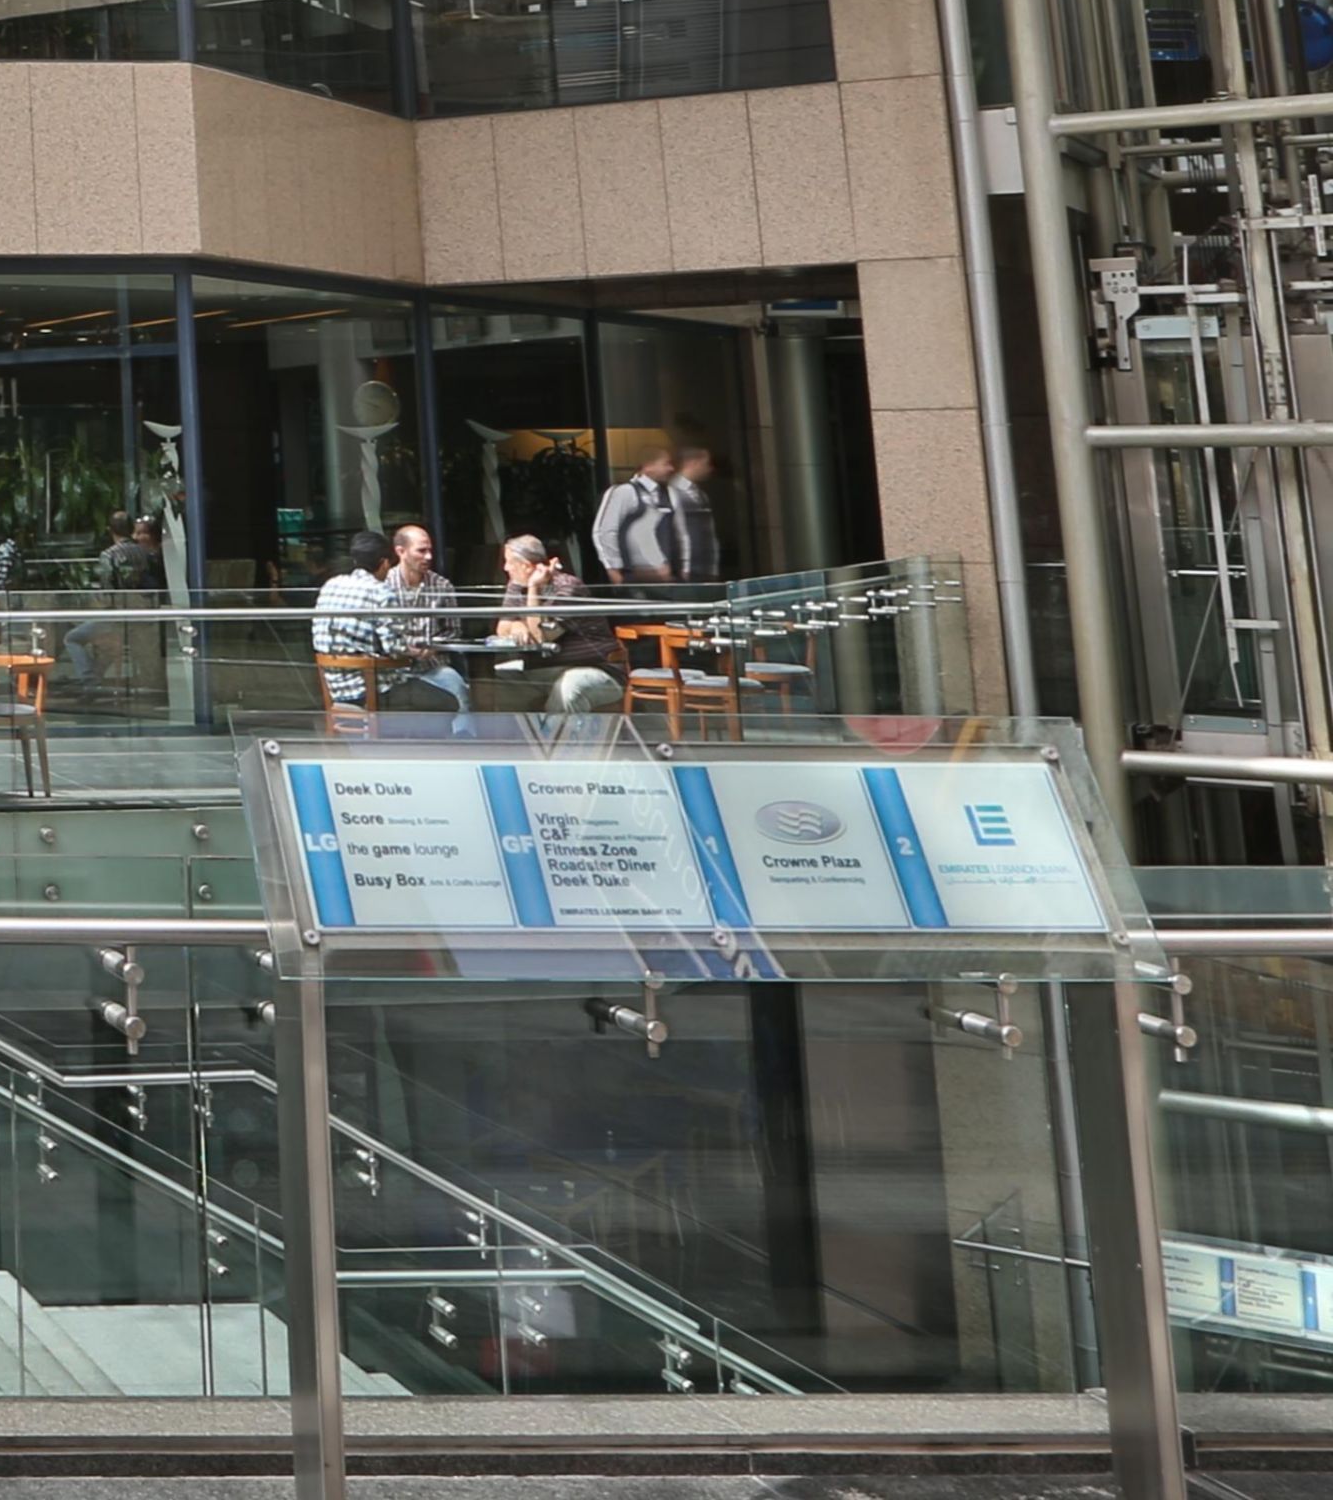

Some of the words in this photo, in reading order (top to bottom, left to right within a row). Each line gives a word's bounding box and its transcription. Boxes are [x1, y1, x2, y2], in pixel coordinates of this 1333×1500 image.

[334, 782, 372, 796] Deek
[375, 782, 413, 796] Duke
[527, 782, 584, 796] Crowne
[586, 782, 626, 796] Plaza
[341, 812, 384, 825] Score
[534, 813, 580, 829] Virgin
[303, 833, 338, 852] LG
[539, 829, 572, 842] C&F
[347, 843, 369, 856] the
[372, 845, 411, 859] game
[414, 843, 459, 859] lounge
[500, 834, 534, 854] GF
[544, 844, 598, 857] Fitness
[601, 844, 638, 857] Zone
[705, 835, 719, 854] 1
[896, 836, 915, 855] 2
[548, 859, 614, 872] Roadster
[617, 859, 657, 872] Diner
[762, 855, 819, 869] Crowne
[821, 855, 862, 869] Plaza
[354, 873, 392, 889] Busy
[396, 873, 426, 887] Box
[552, 874, 590, 887] Deek
[593, 874, 630, 887] Duke
